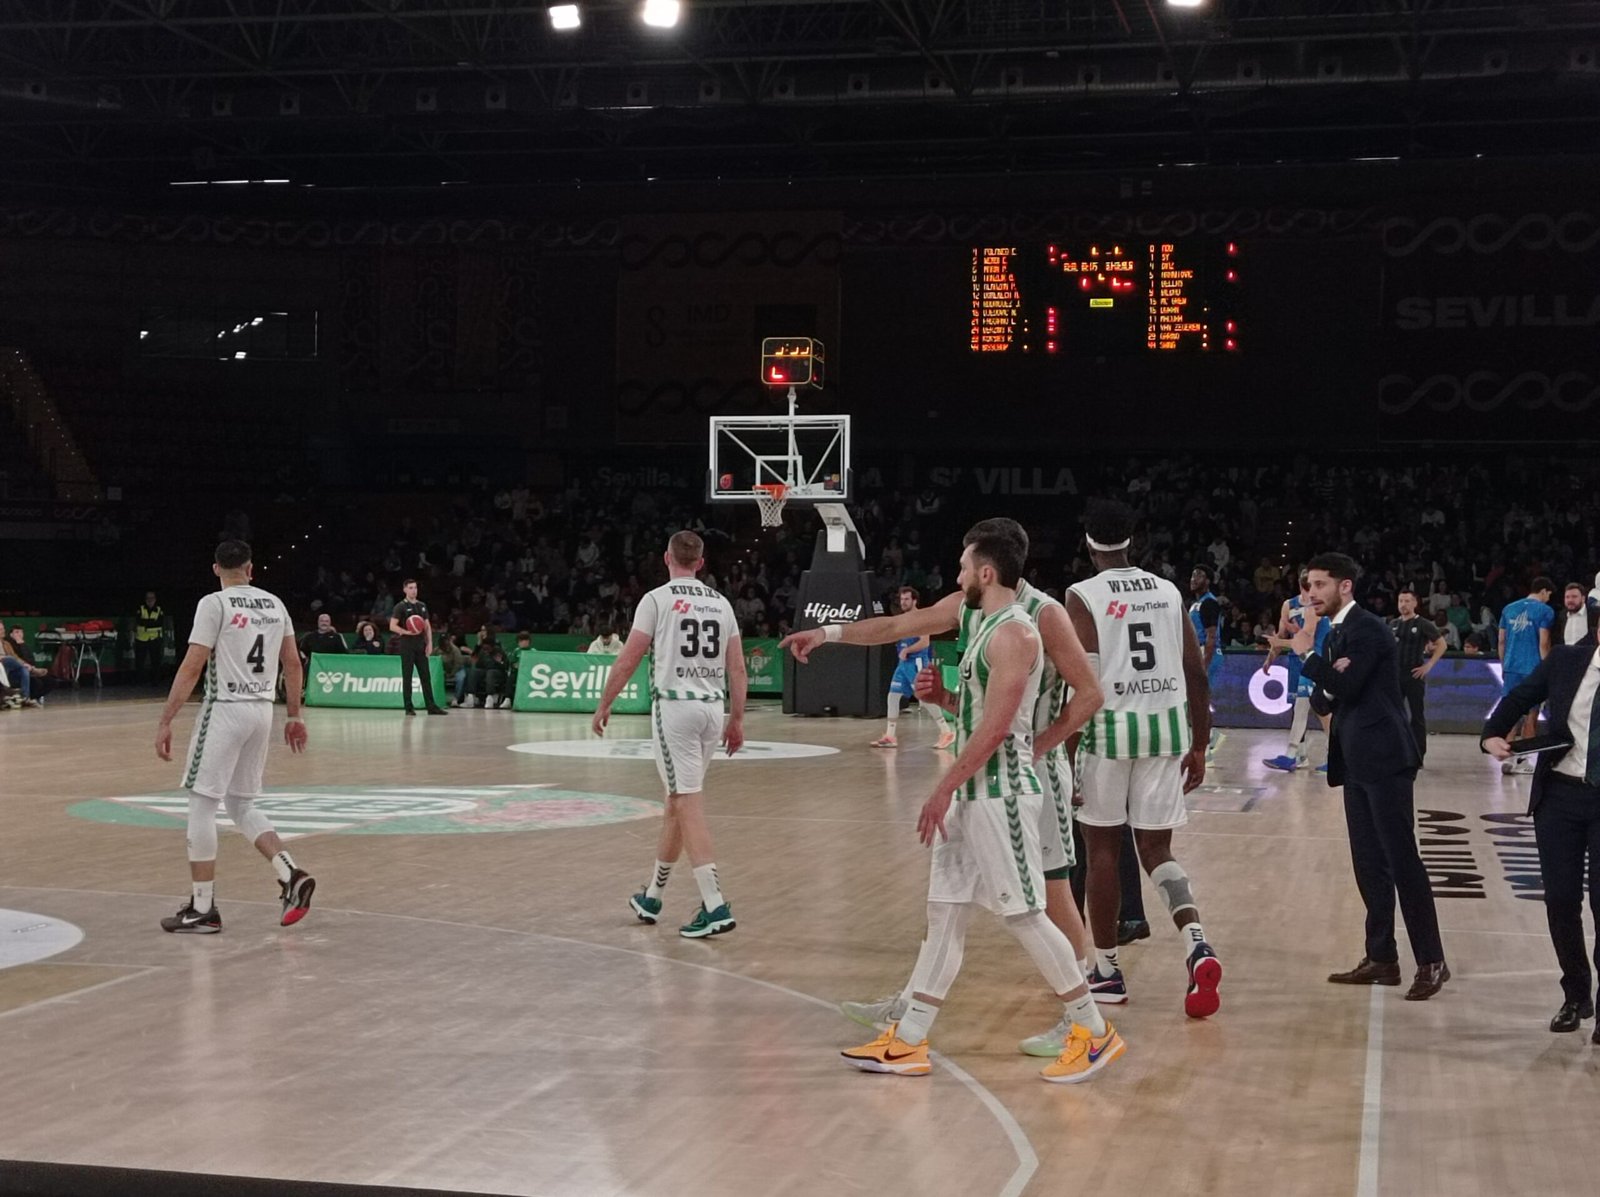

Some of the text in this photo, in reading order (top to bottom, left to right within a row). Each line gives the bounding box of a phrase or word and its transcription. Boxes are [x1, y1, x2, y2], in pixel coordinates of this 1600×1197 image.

[1107, 578, 1158, 593] WEMBI
[804, 602, 862, 624] Hijole!
[680, 618, 720, 659] 33
[1128, 622, 1156, 672] 5
[246, 633, 264, 673] 4
[685, 666, 724, 679] MEDAC
[1126, 677, 1178, 695] MEDAC
